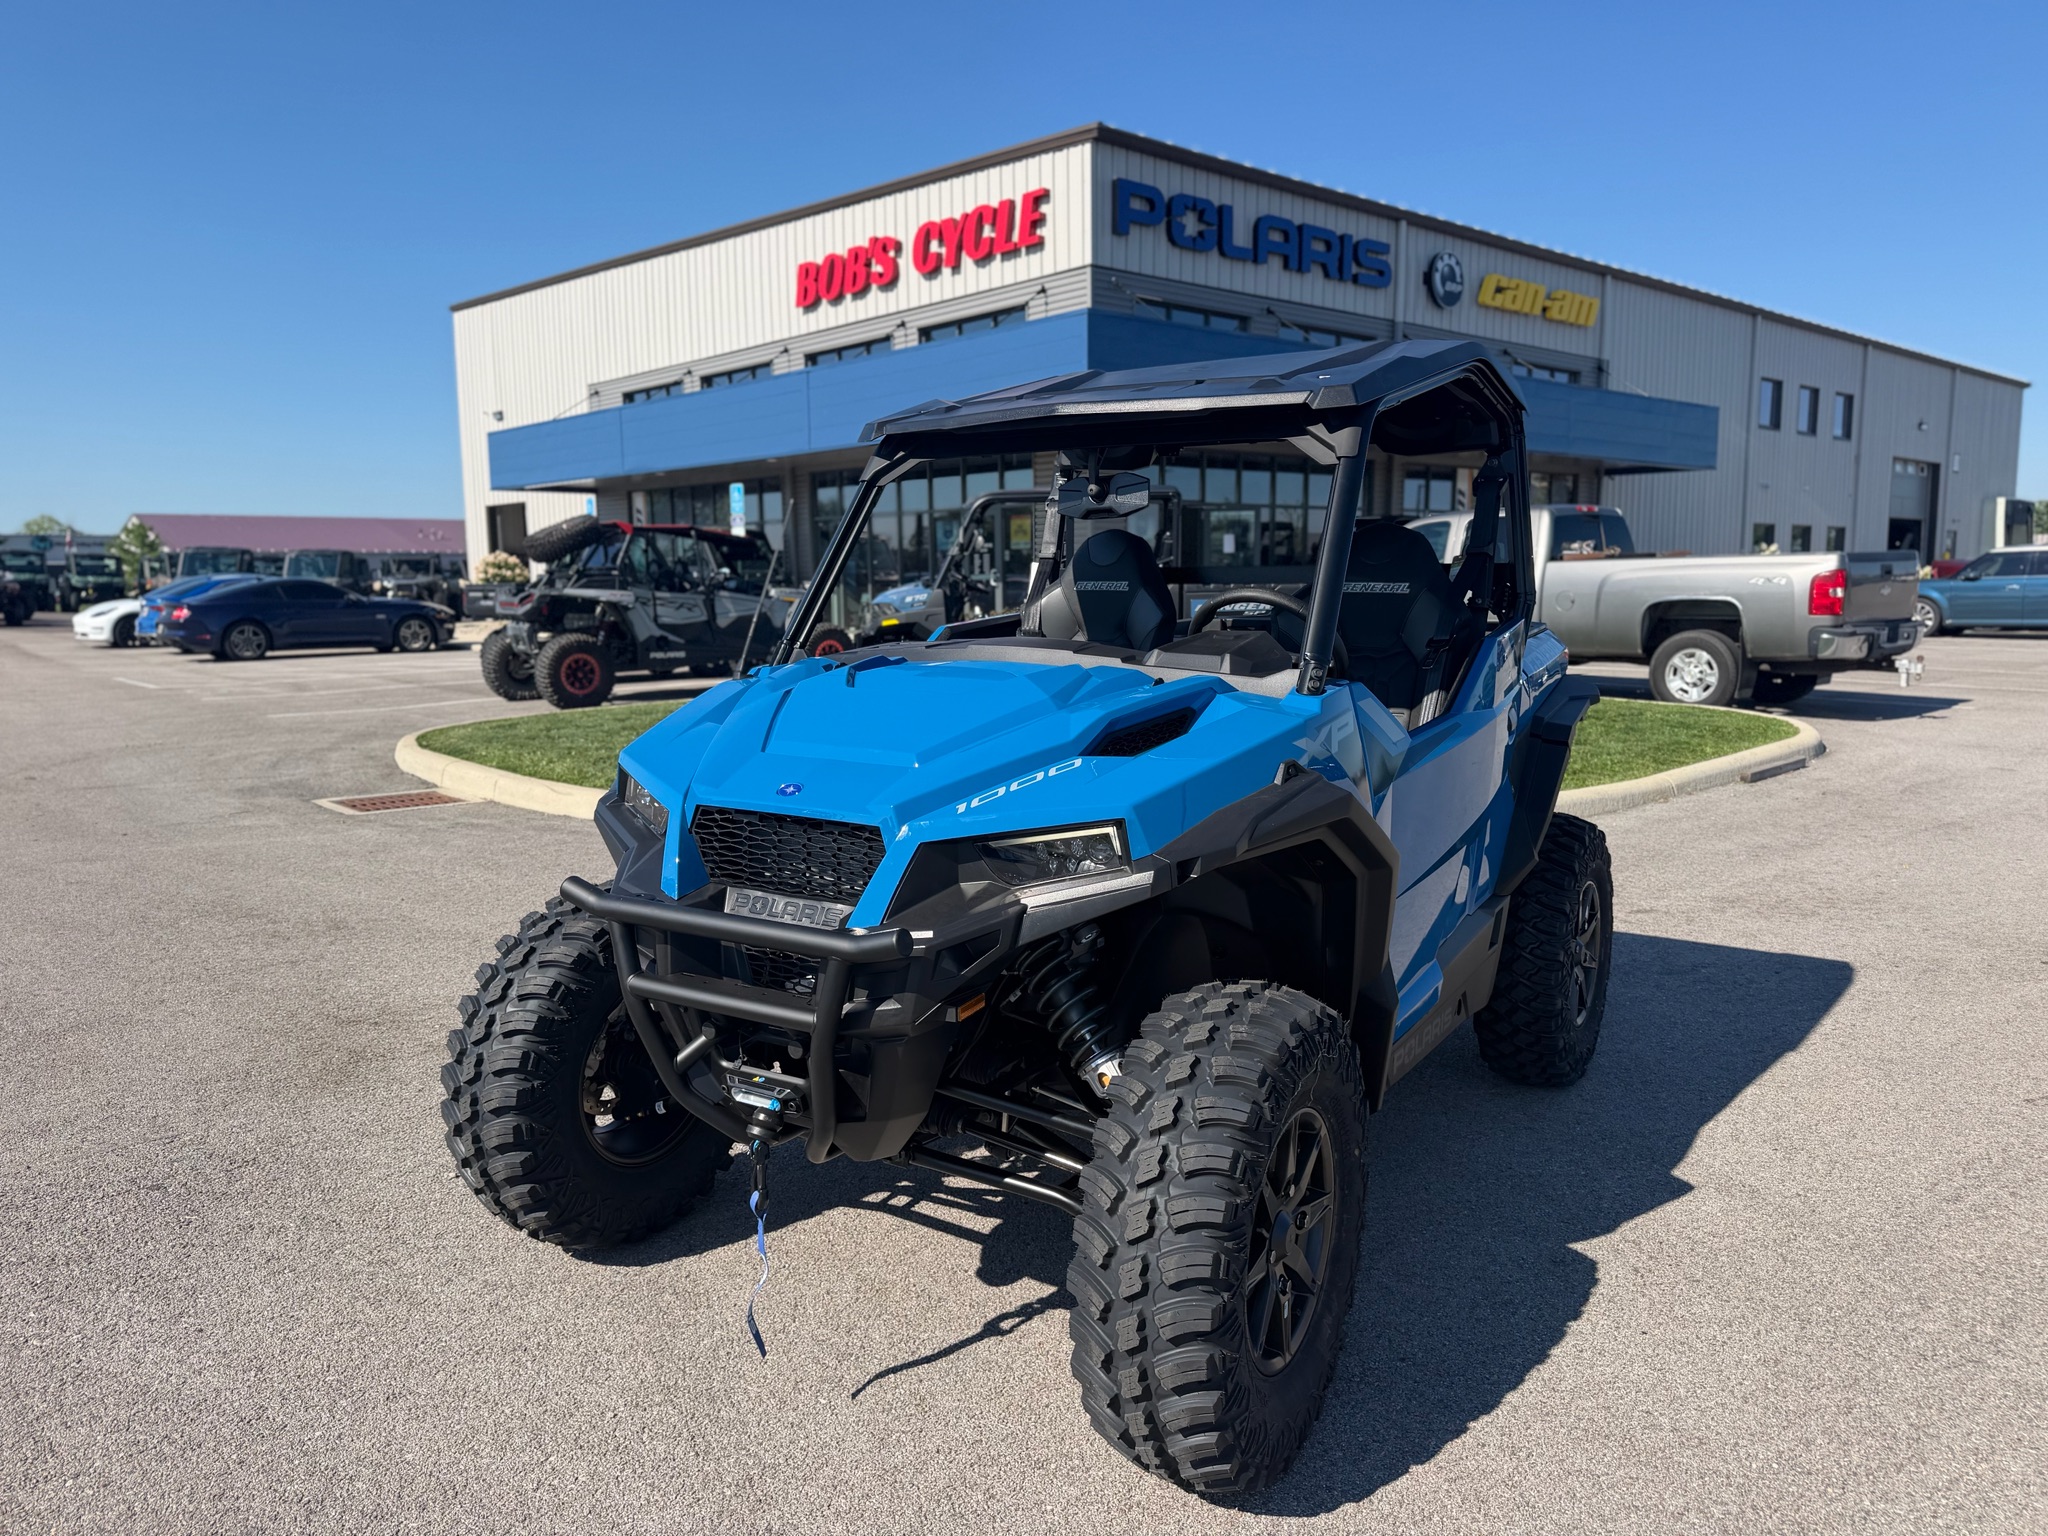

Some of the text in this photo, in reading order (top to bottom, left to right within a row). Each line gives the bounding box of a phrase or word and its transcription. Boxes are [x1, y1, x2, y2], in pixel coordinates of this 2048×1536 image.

[796, 187, 1050, 309] BOB'S CYCLE
[1112, 177, 1392, 289] POLARIS
[1074, 581, 1129, 591] GENERAL
[1292, 708, 1355, 766] XP
[956, 758, 1083, 815] 1000
[731, 892, 845, 929] POLARIS
[1393, 1006, 1454, 1075] POLARIS
